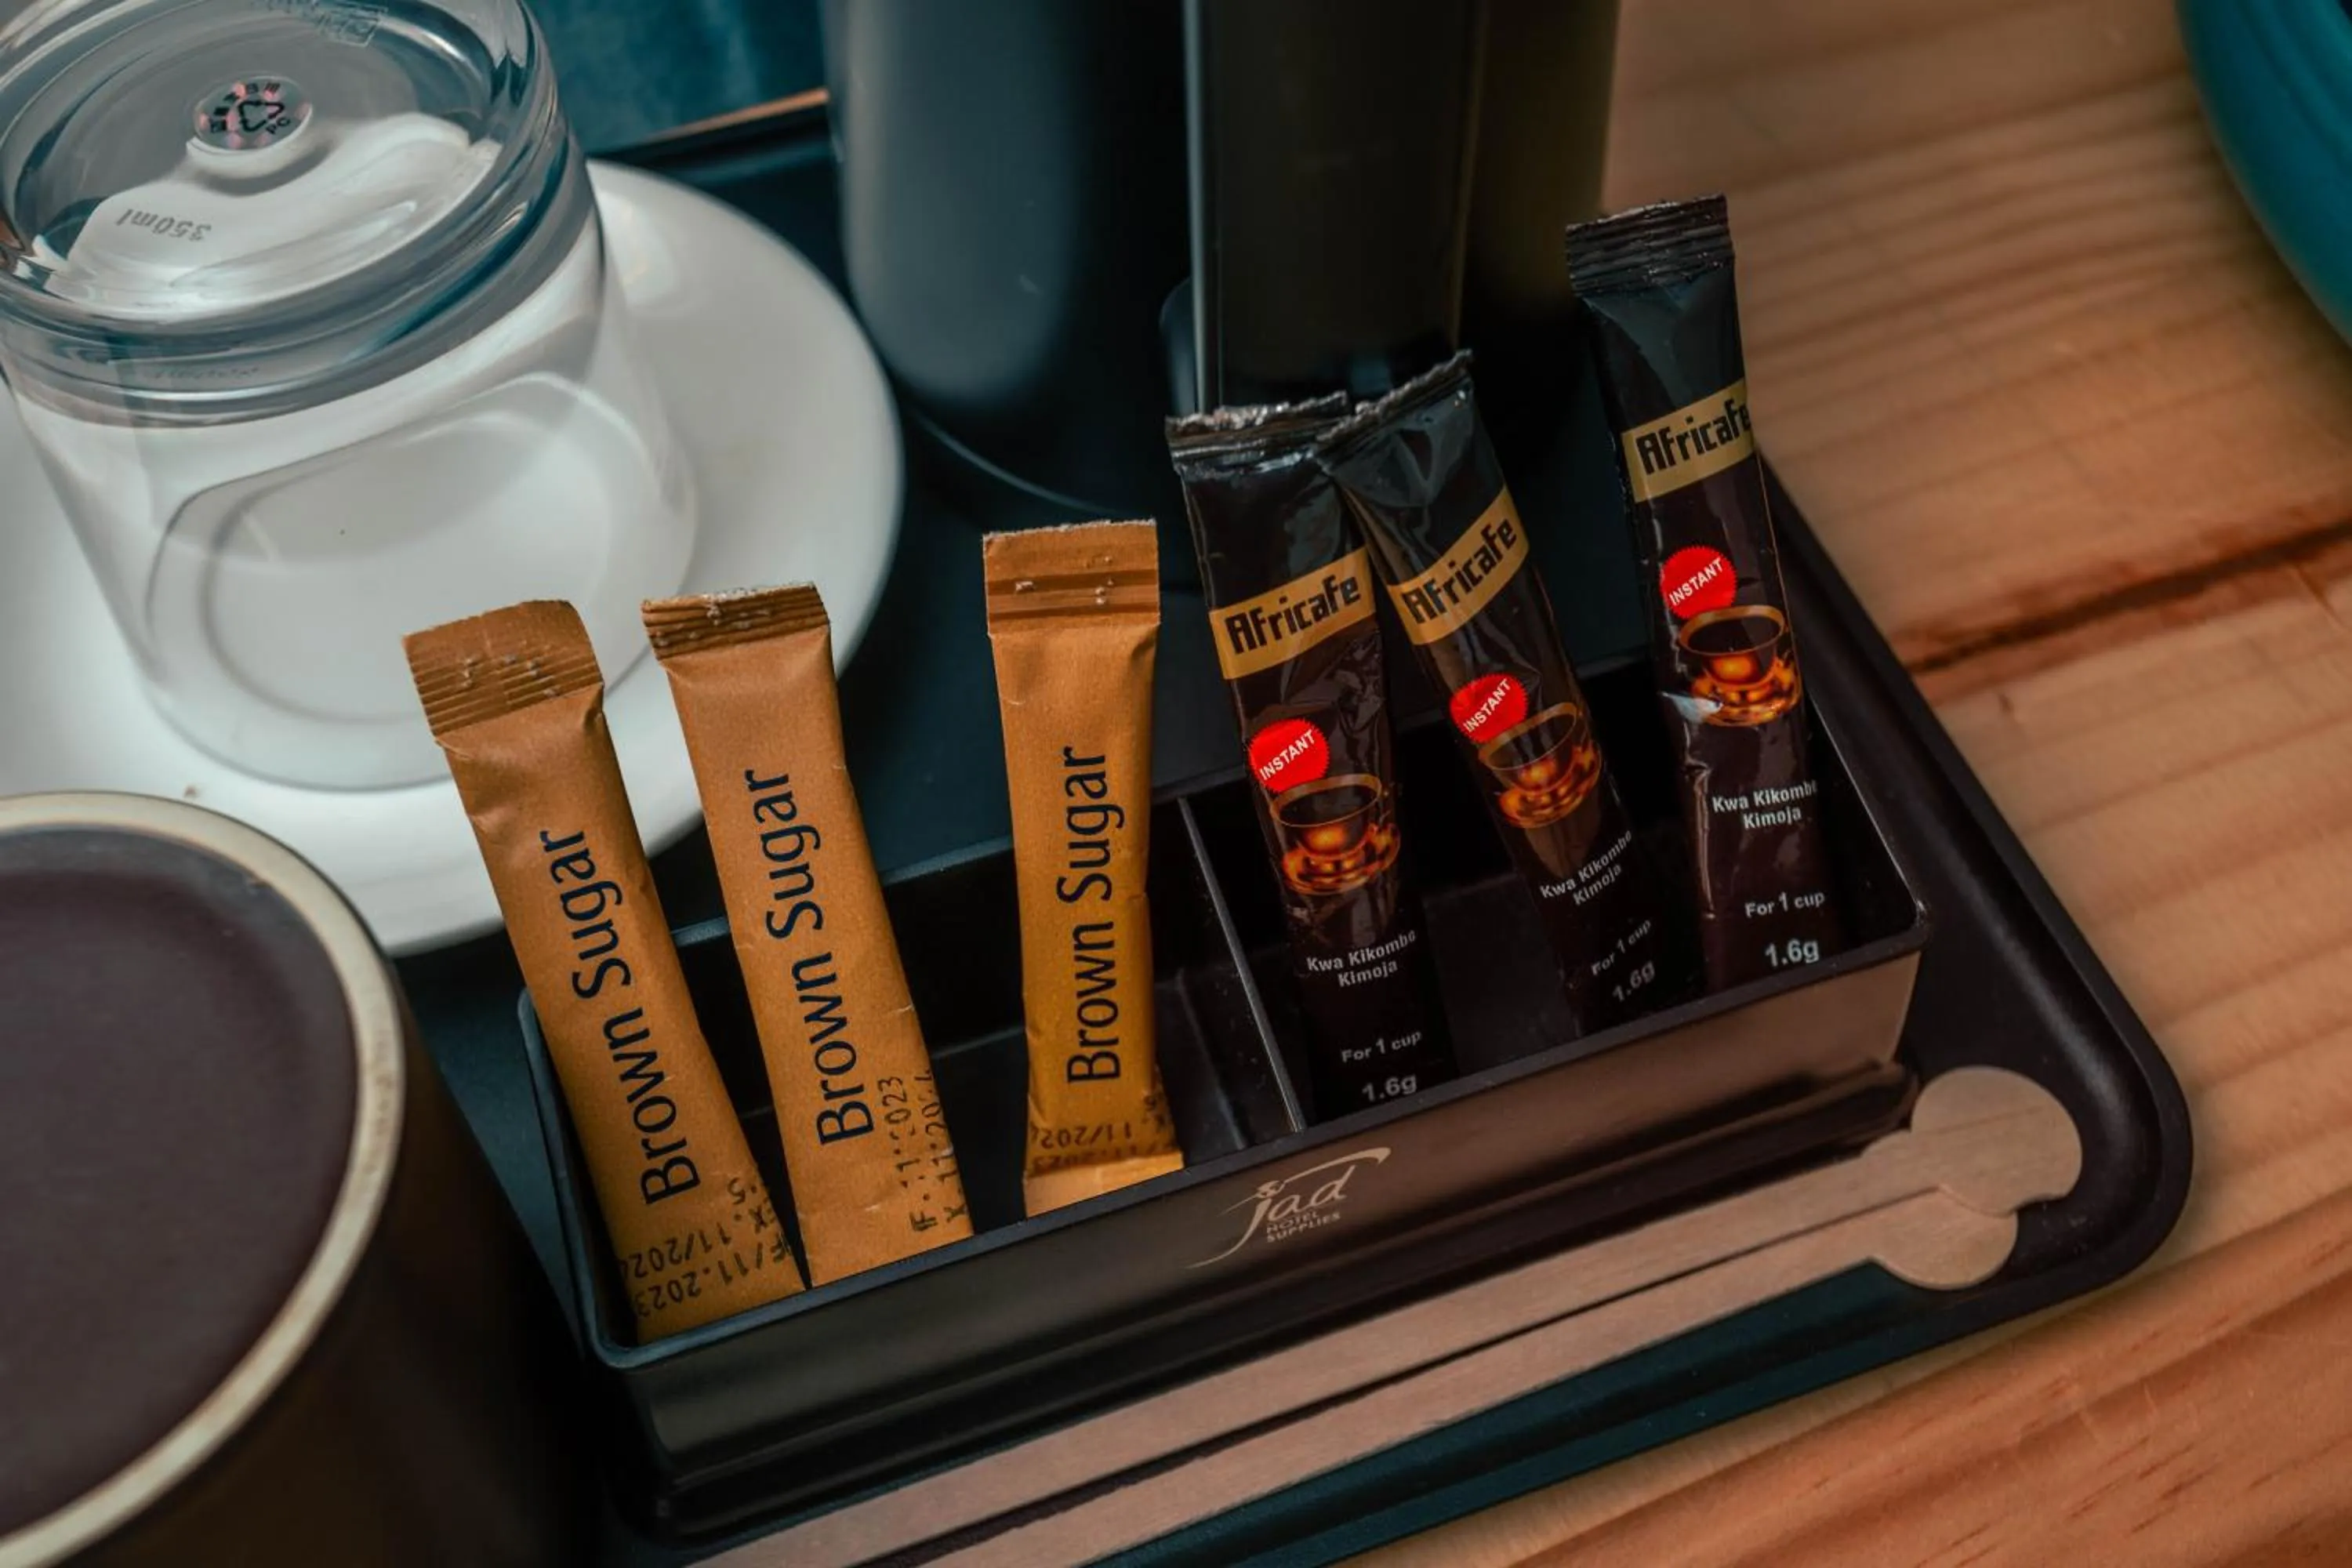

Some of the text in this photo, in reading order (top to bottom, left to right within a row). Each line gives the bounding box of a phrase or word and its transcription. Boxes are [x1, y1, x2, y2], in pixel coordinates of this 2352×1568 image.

[115, 209, 212, 241] 350ml
[1669, 557, 1724, 606] INSTANT
[1462, 678, 1512, 734] INSTANT
[1259, 729, 1316, 781] INSTANT
[1056, 746, 1125, 904] Sugar
[1712, 797, 1749, 813] Kwa
[1743, 807, 1802, 829] Kimoja
[1540, 830, 1632, 898] Kwa Kikombo
[1573, 863, 1623, 906] Kimoja
[1745, 891, 1825, 918] For 1 cup
[745, 769, 874, 1145] Brown Sugar
[1306, 930, 1416, 972] Kwa Kikombo
[1591, 920, 1652, 976] For 1 cup
[1766, 938, 1820, 967] 1.6g
[1338, 960, 1399, 988] Kimoja
[1612, 960, 1656, 1003] 1.6g
[539, 829, 700, 1205] Brown Sugar
[1067, 921, 1121, 1083] Brown
[1341, 1030, 1422, 1062] For 1 cup
[1362, 1074, 1417, 1102] 1.6g
[1266, 1211, 1341, 1243] SUPPLIES
